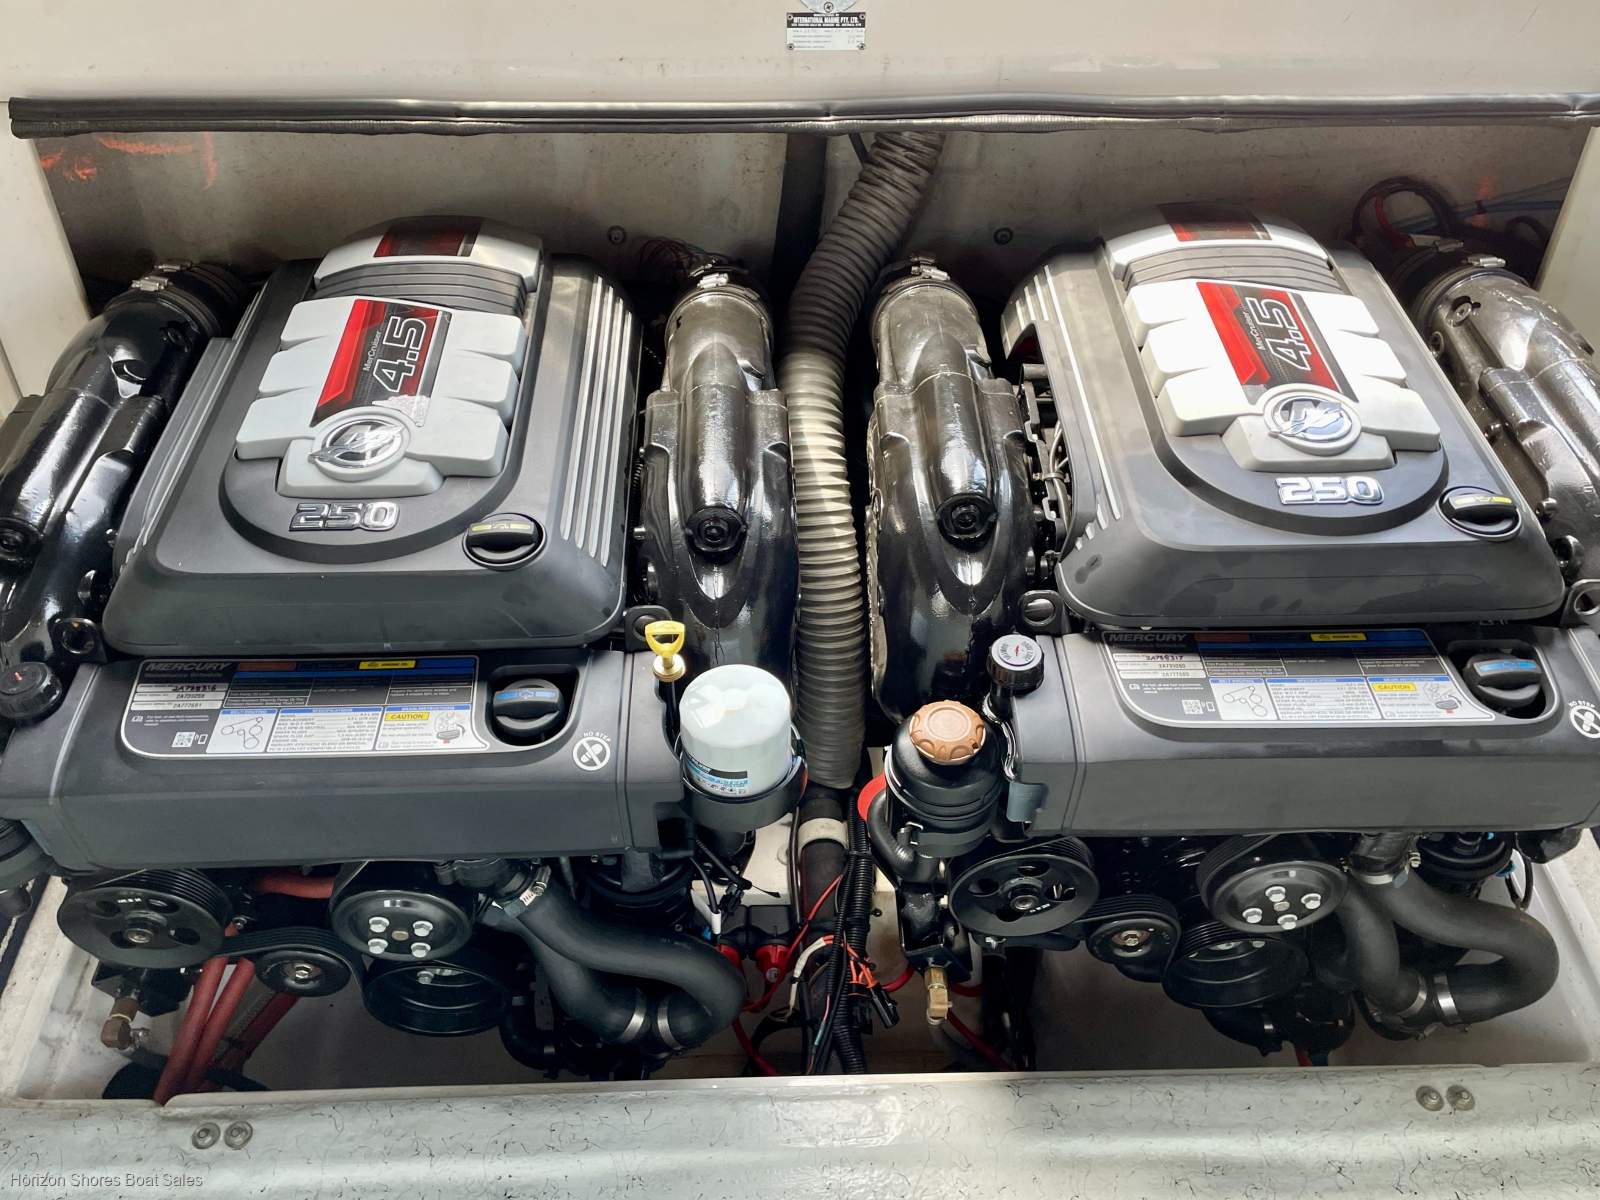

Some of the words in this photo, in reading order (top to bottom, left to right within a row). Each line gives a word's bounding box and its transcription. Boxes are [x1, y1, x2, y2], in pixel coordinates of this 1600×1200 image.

[1242, 310, 1266, 350] MerCruiser
[1245, 297, 1312, 371] 4.5
[363, 330, 382, 372] MerCruiser
[373, 316, 427, 393] 4.5
[1275, 476, 1384, 505] 250
[288, 501, 400, 532] 250
[1108, 633, 1187, 642] MERCURY
[145, 662, 232, 671] MERCURY
[595, 731, 611, 742] STEP
